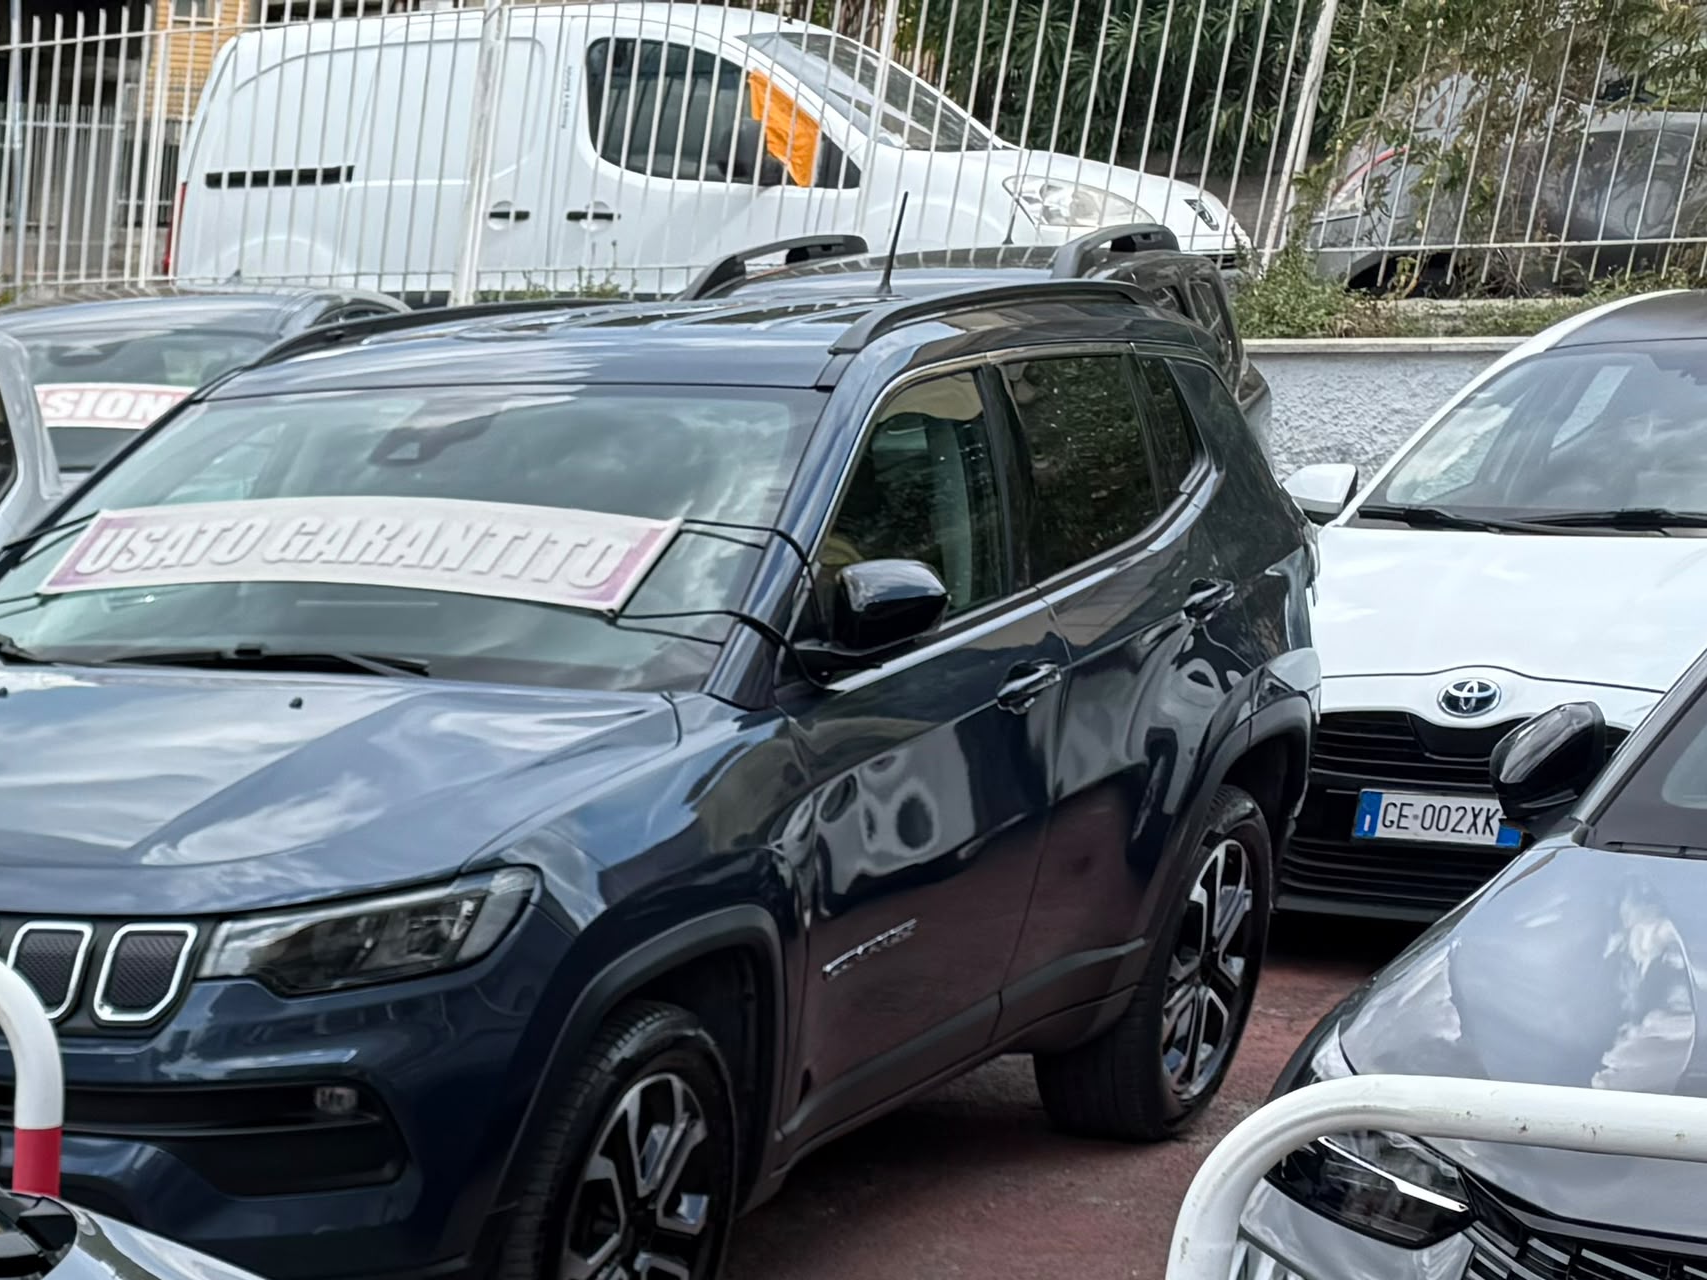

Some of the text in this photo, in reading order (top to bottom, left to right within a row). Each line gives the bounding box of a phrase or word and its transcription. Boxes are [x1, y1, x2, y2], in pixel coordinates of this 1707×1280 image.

[74, 515, 635, 589] USATO GARANTITO
[1381, 802, 1414, 830] GE
[1420, 803, 1501, 837] 002XK
